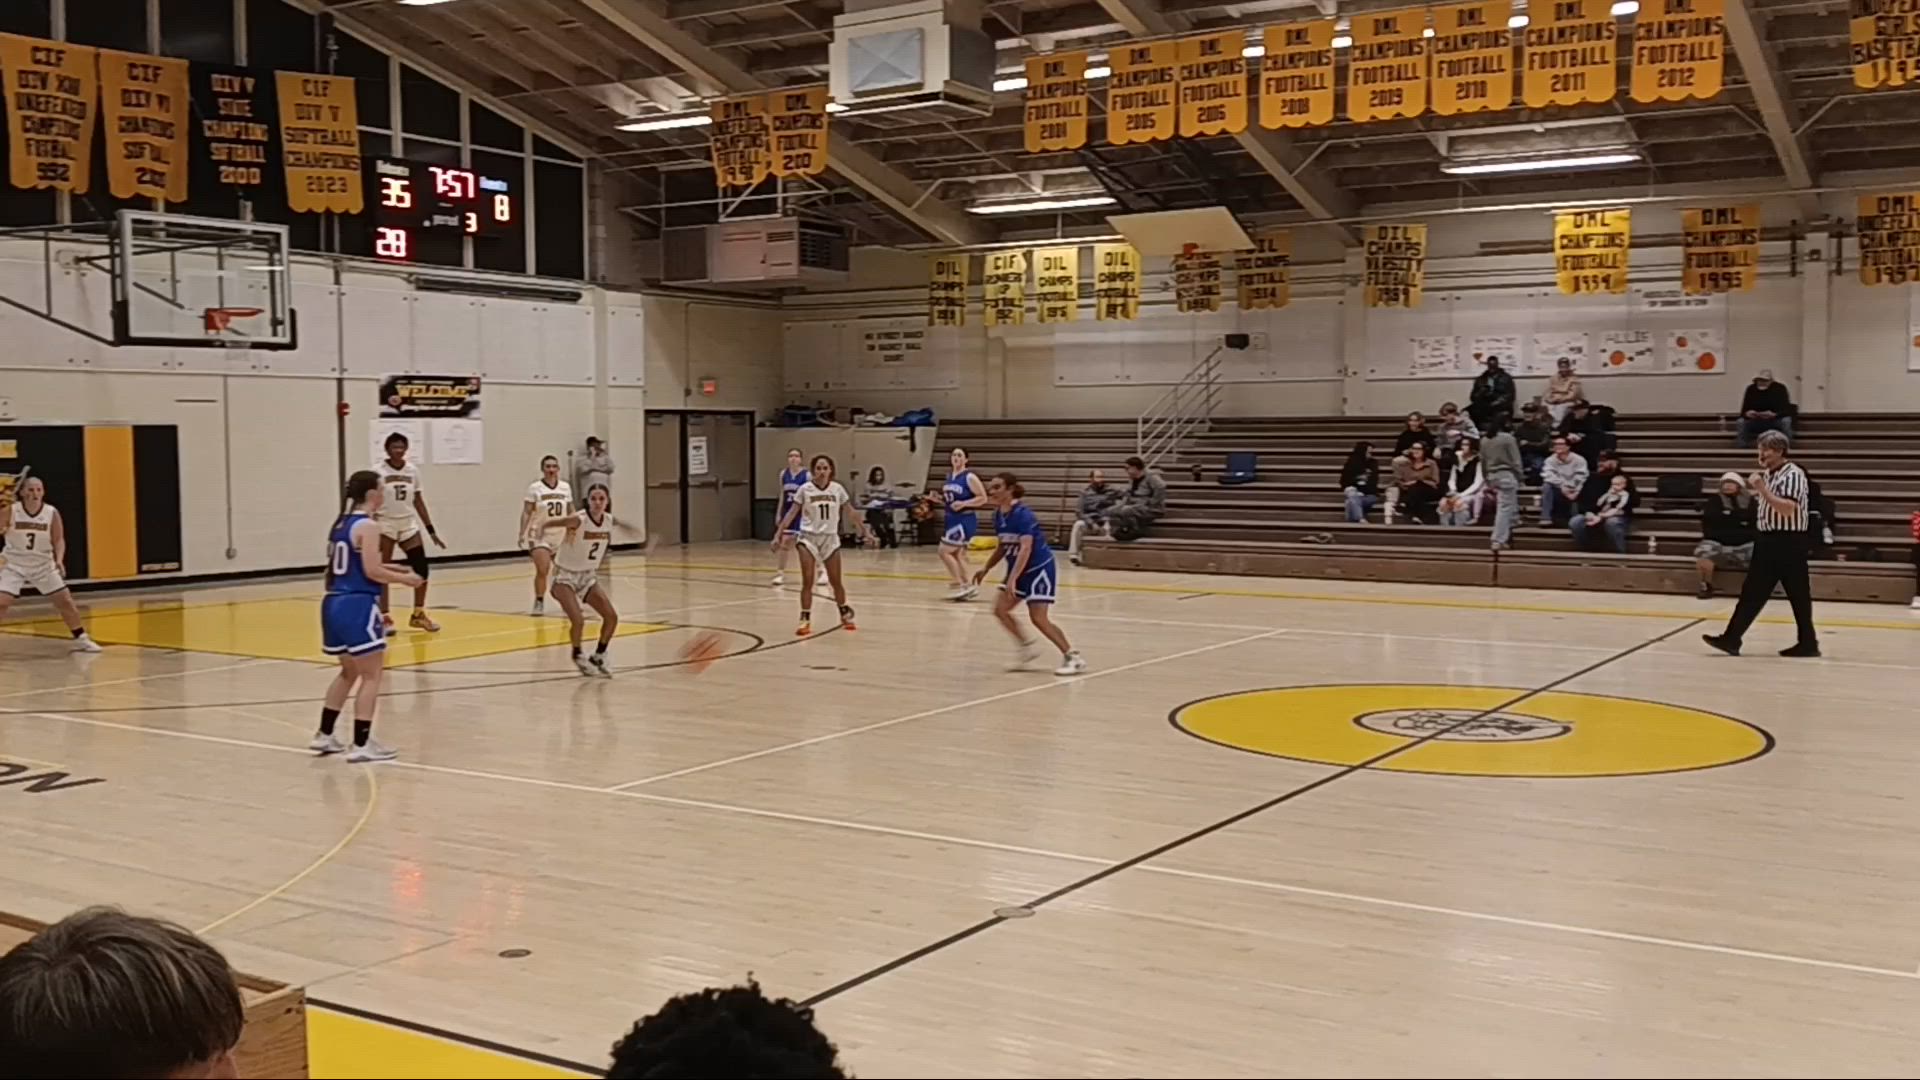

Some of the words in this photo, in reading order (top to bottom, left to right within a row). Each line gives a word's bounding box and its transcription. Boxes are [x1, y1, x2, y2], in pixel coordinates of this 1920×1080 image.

[1526, 21, 1616, 47] CHAMPIONS
[1636, 16, 1723, 41] CHAMPIONS
[1351, 37, 1424, 62] CHAMPIONS
[1435, 29, 1510, 53] CHAMPIONS
[31, 47, 66, 67] CIF
[1263, 50, 1332, 71] CHAMPIONS
[1529, 46, 1609, 71] FOOTBALL
[1637, 41, 1718, 66] FOOTBALL
[128, 63, 163, 83] CIF
[1181, 58, 1243, 81] CHAMPIONS
[1353, 62, 1420, 86] FOOTBALL
[1437, 55, 1506, 78] FOOTBALL
[302, 79, 331, 97] CIF
[1111, 67, 1174, 89] CHAMPIONS
[1265, 73, 1328, 95] FOOTBALL
[1551, 72, 1586, 93] 2011
[1658, 68, 1695, 88] 2012
[1026, 80, 1087, 101] CHAMPIONS
[1112, 89, 1170, 111] FOOTBALL
[1183, 80, 1241, 104] FOOTBALL
[294, 103, 323, 121] DIV
[328, 105, 341, 122] V
[1027, 101, 1083, 122] FOOTBALL
[285, 126, 356, 147] SOFTBALL
[286, 150, 361, 171] CHAMPIONS
[307, 175, 348, 193] 2023
[494, 194, 510, 221] 8
[465, 212, 478, 232] 3
[375, 227, 407, 257] 28
[1367, 241, 1422, 256] CHAMPS
[1559, 232, 1625, 249] CHAMPIONS
[1685, 229, 1758, 248] CHAMPIONS
[993, 254, 1017, 270] CIF
[1365, 256, 1424, 272] VARSITY
[1562, 254, 1619, 270] FOOTBALL
[1686, 250, 1753, 268] FOOTBALL
[1367, 271, 1418, 287] FOOTBALL
[393, 484, 406, 501] 15
[547, 501, 562, 517] 20
[818, 503, 829, 520] 11
[26, 533, 36, 550] 3
[588, 542, 599, 560] 2
